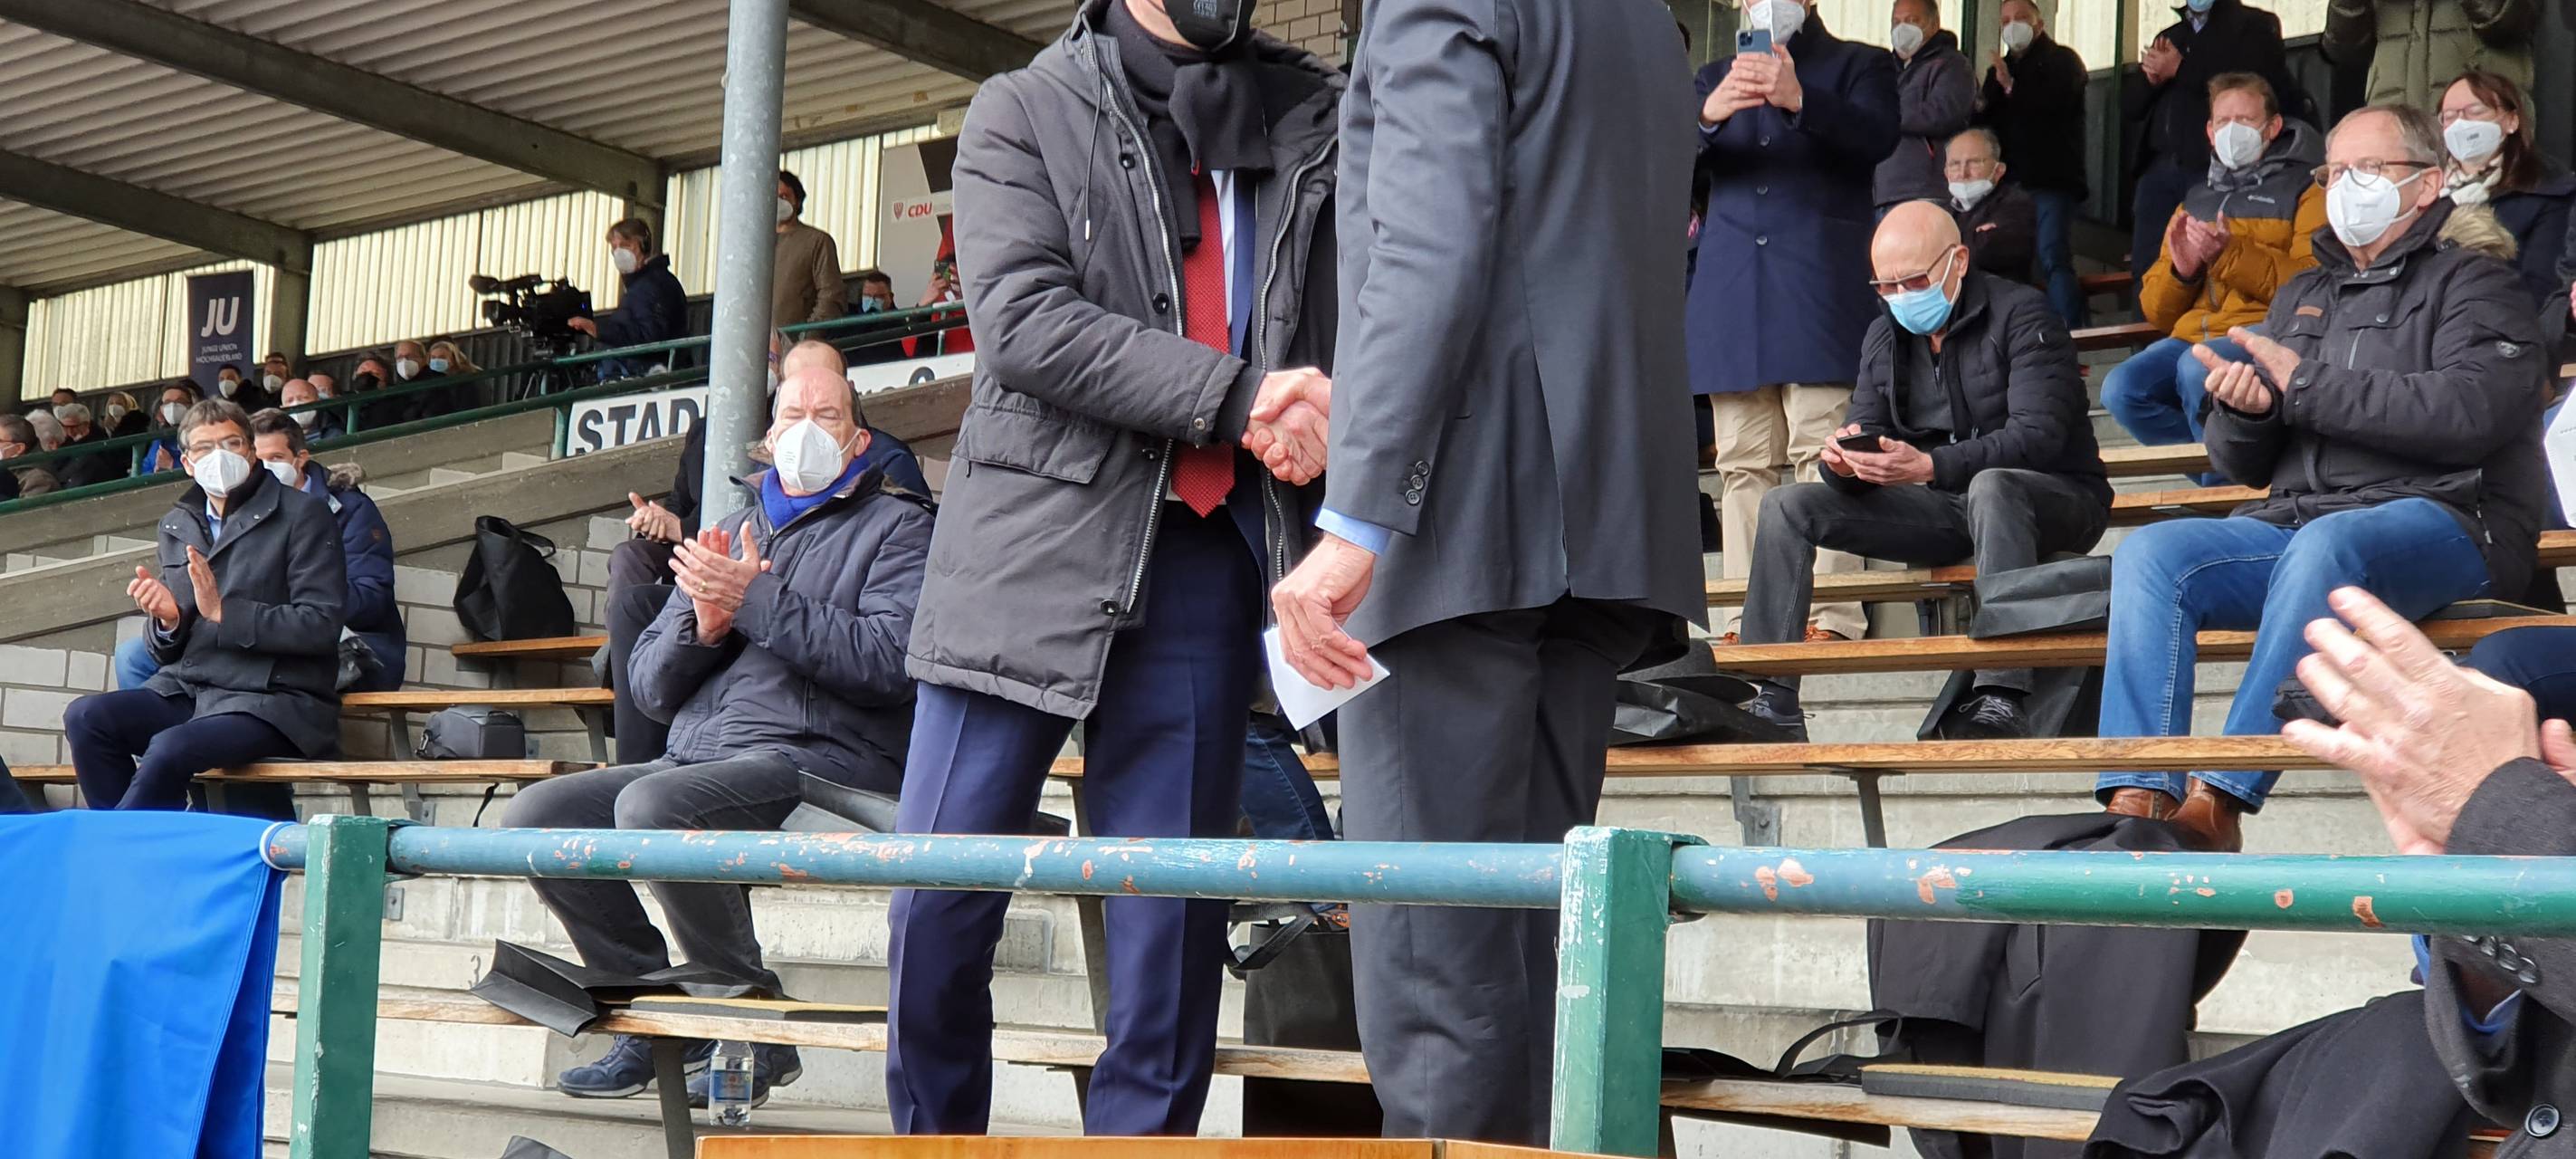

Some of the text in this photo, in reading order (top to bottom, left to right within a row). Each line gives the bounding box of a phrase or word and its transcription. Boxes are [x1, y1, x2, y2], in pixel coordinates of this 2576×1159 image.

[908, 201, 932, 217] CDU
[201, 296, 240, 338] JU
[574, 395, 709, 455] STAD
